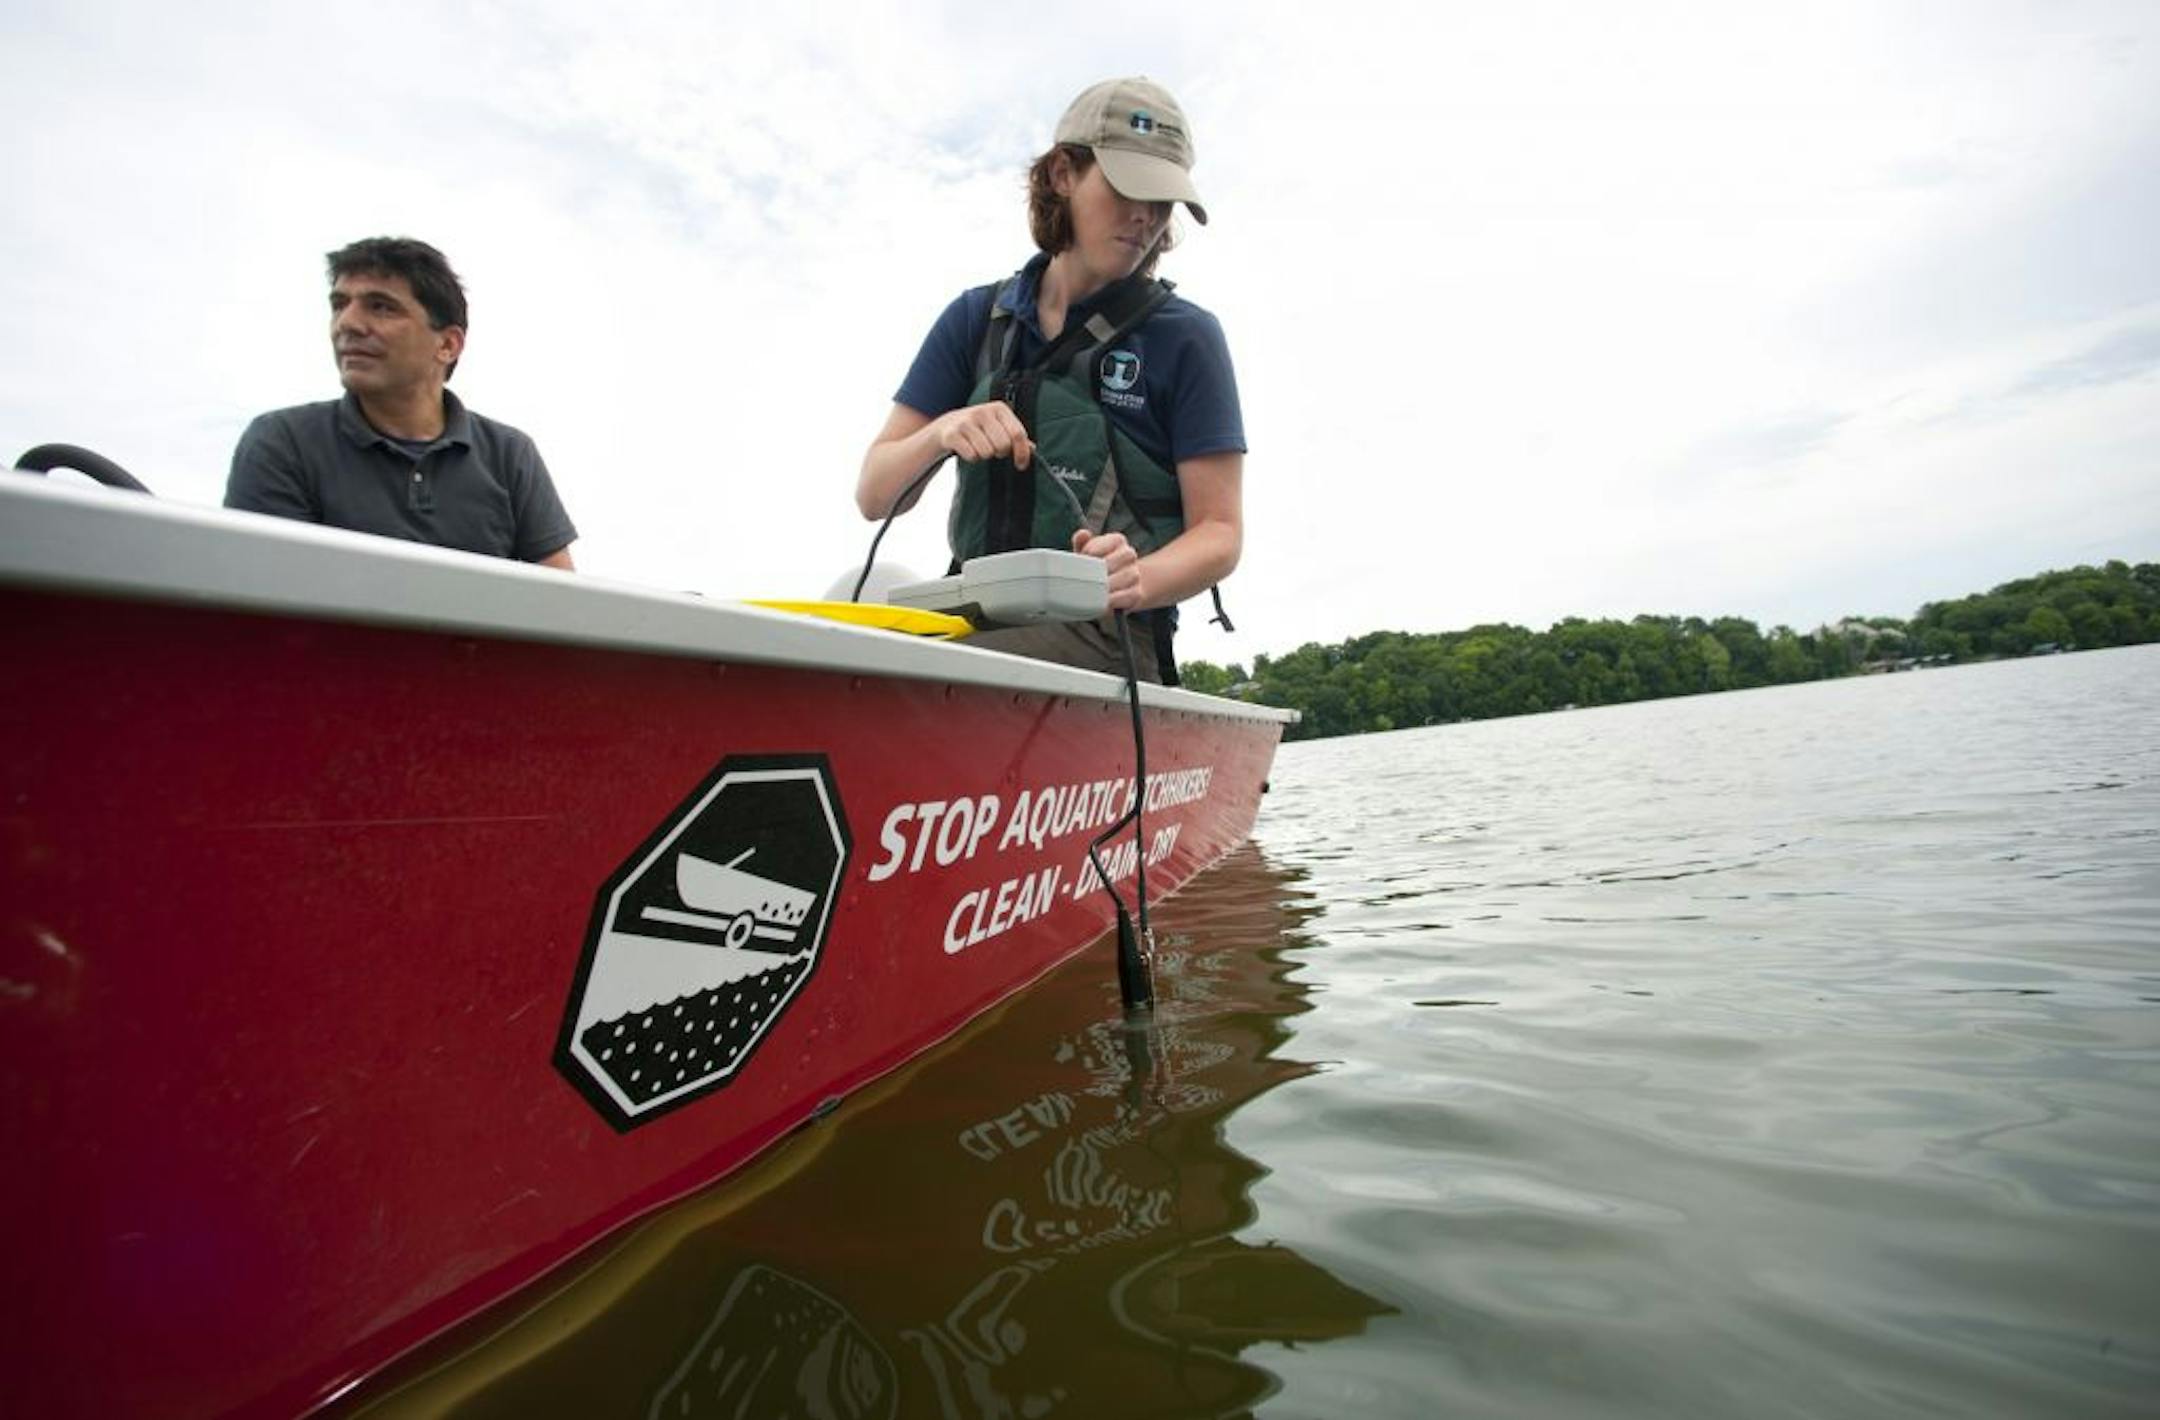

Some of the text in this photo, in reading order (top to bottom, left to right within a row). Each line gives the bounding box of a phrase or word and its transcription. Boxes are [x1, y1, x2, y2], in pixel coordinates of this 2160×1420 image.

[868, 766, 1214, 882] STOP AQUATIC HTCHHIKERS!
[944, 864, 1062, 955] CLEAN
[1147, 822, 1182, 867] DRY
